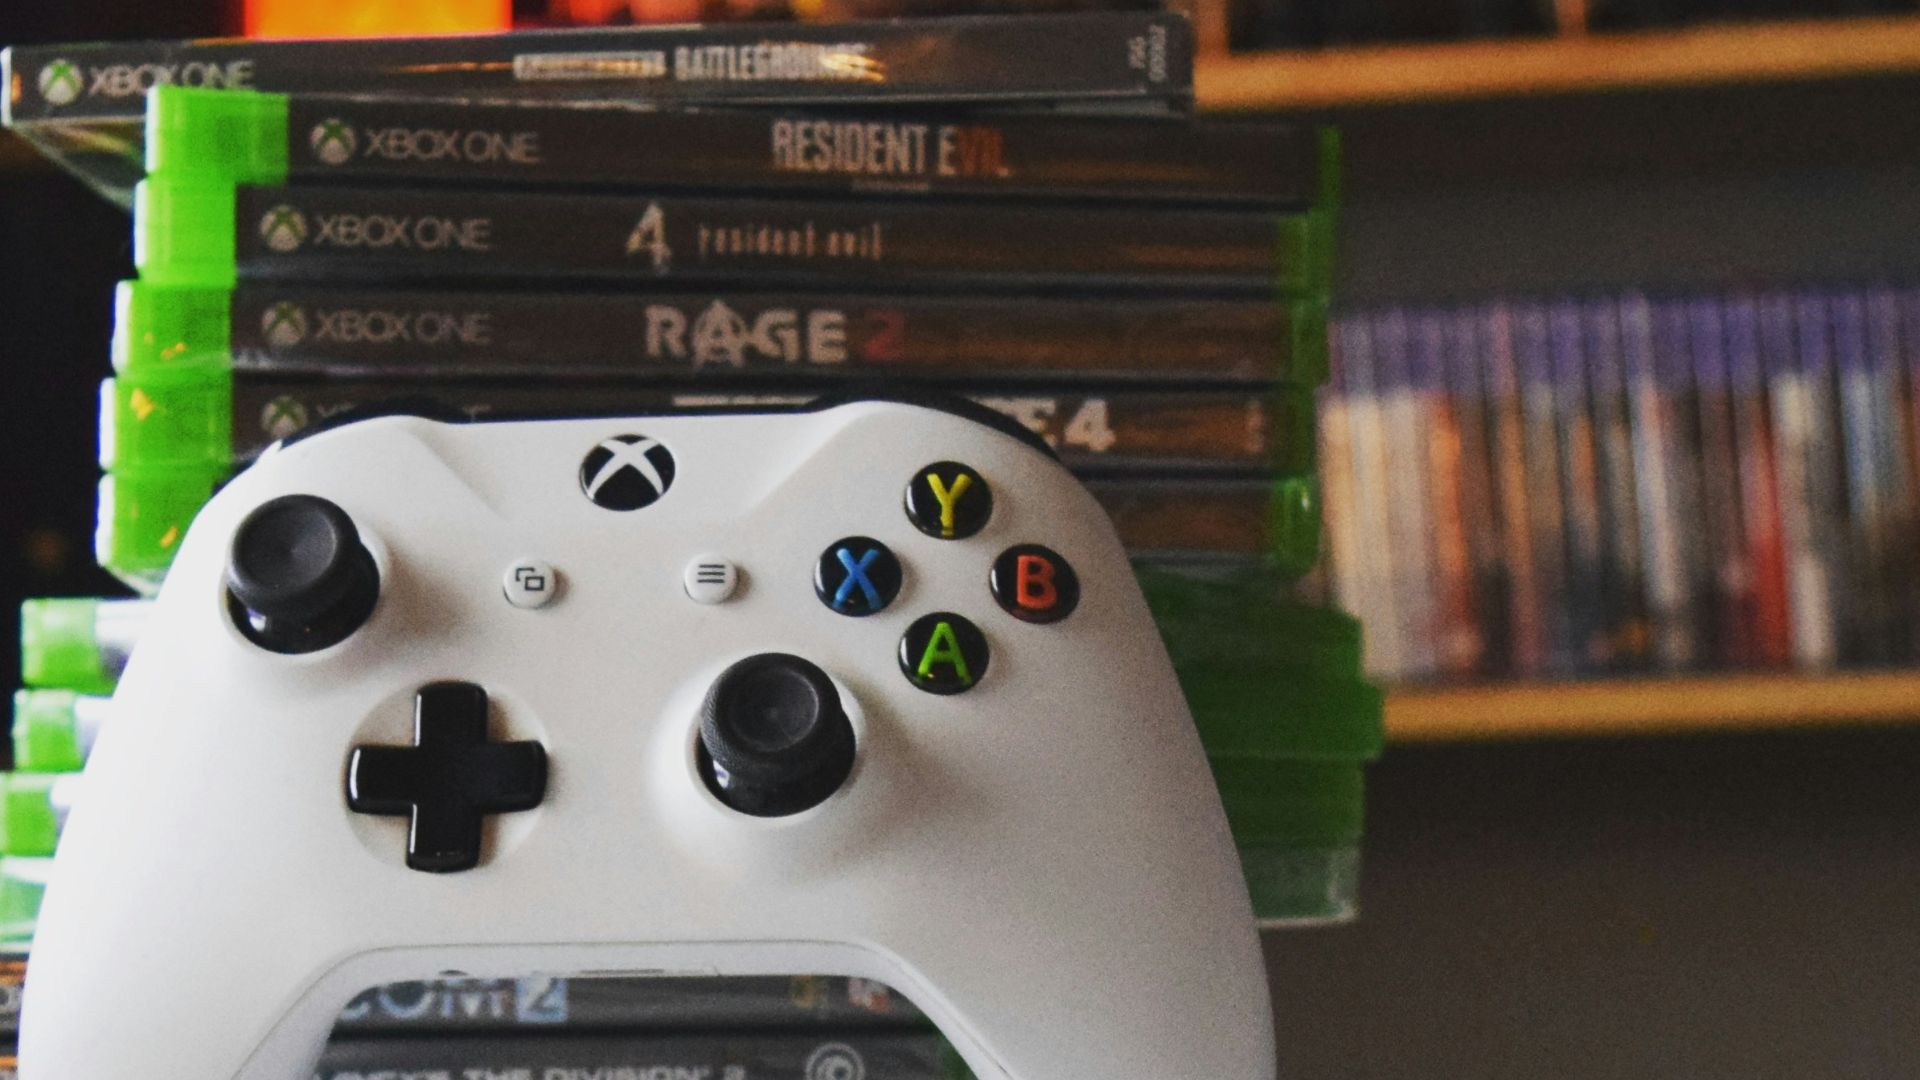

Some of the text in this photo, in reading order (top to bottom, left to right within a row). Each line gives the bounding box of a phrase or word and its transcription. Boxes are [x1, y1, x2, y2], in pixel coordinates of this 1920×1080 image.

[364, 129, 541, 163] XBOX ONE
[772, 118, 927, 174] RESIDENT
[314, 217, 492, 250] XBOX ONE
[625, 203, 672, 277] 4
[314, 310, 493, 345] XBOX ONE
[644, 300, 904, 369] RAGE 2
[926, 473, 972, 536] Y
[834, 548, 881, 609] X
[1016, 553, 1058, 609] B
[917, 622, 972, 685] A
